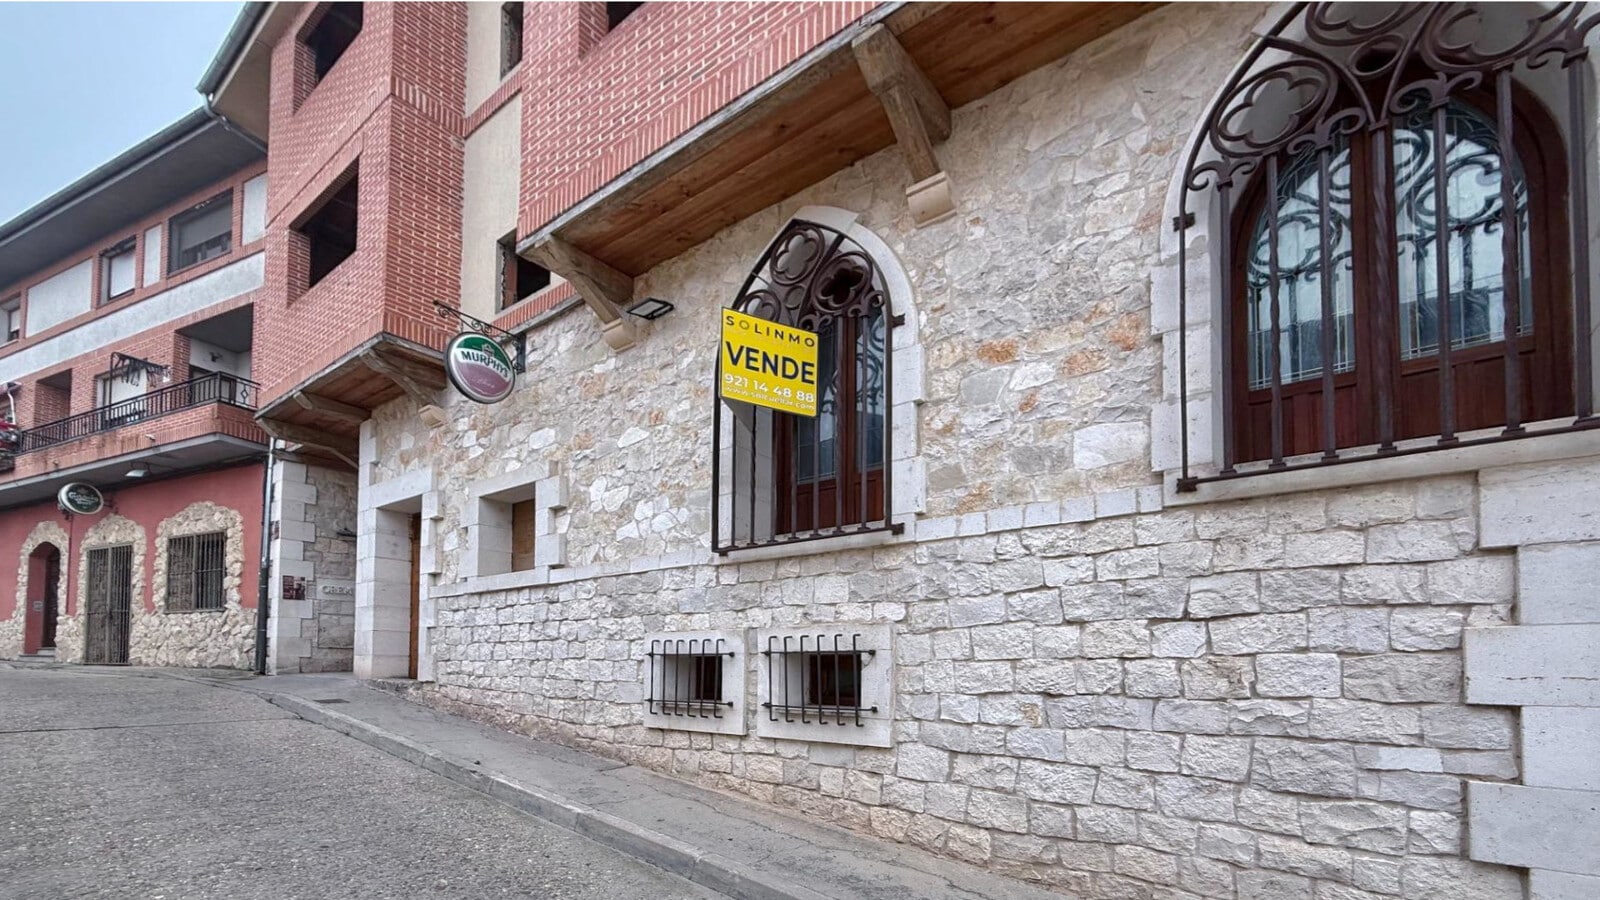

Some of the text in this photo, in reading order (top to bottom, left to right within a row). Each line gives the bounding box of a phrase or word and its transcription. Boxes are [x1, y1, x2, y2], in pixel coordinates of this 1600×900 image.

[726, 315, 815, 347] SOLINMO
[725, 341, 815, 385] VENDE
[725, 373, 814, 403] 921 14 48 88
